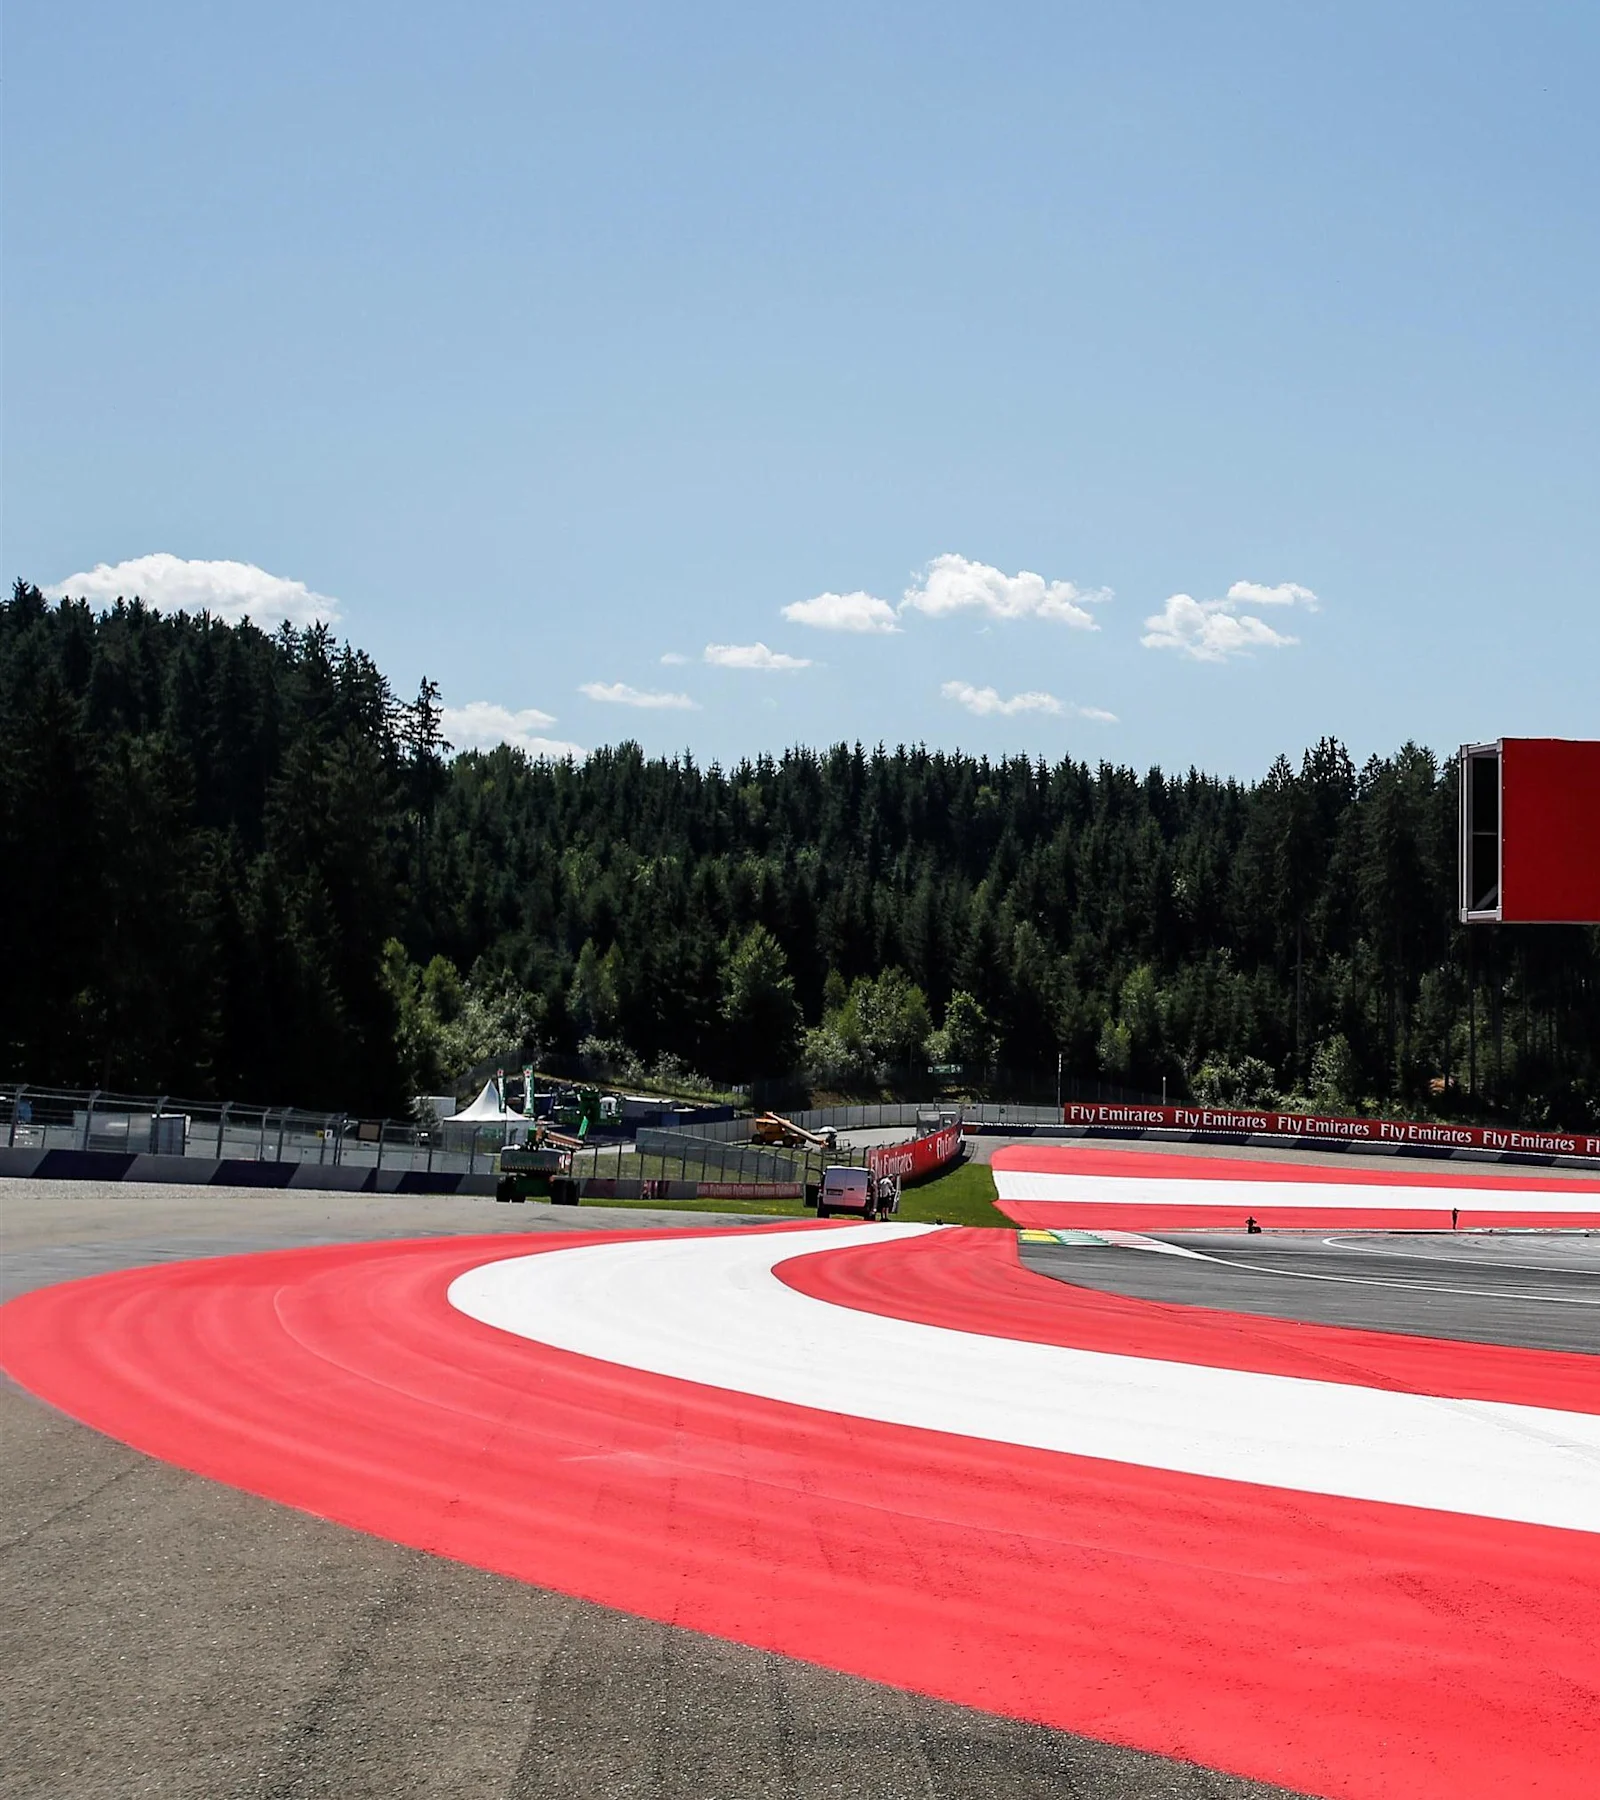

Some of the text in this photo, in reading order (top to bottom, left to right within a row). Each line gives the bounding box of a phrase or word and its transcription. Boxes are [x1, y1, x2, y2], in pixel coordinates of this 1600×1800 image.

[1070, 1105, 1164, 1123] Fly Emirates
[1175, 1110, 1267, 1128] Fly Emirates
[1278, 1116, 1370, 1136] Fly Emirates
[1380, 1123, 1472, 1143] Fly Emirates
[1483, 1131, 1575, 1151] Fly Emirates
